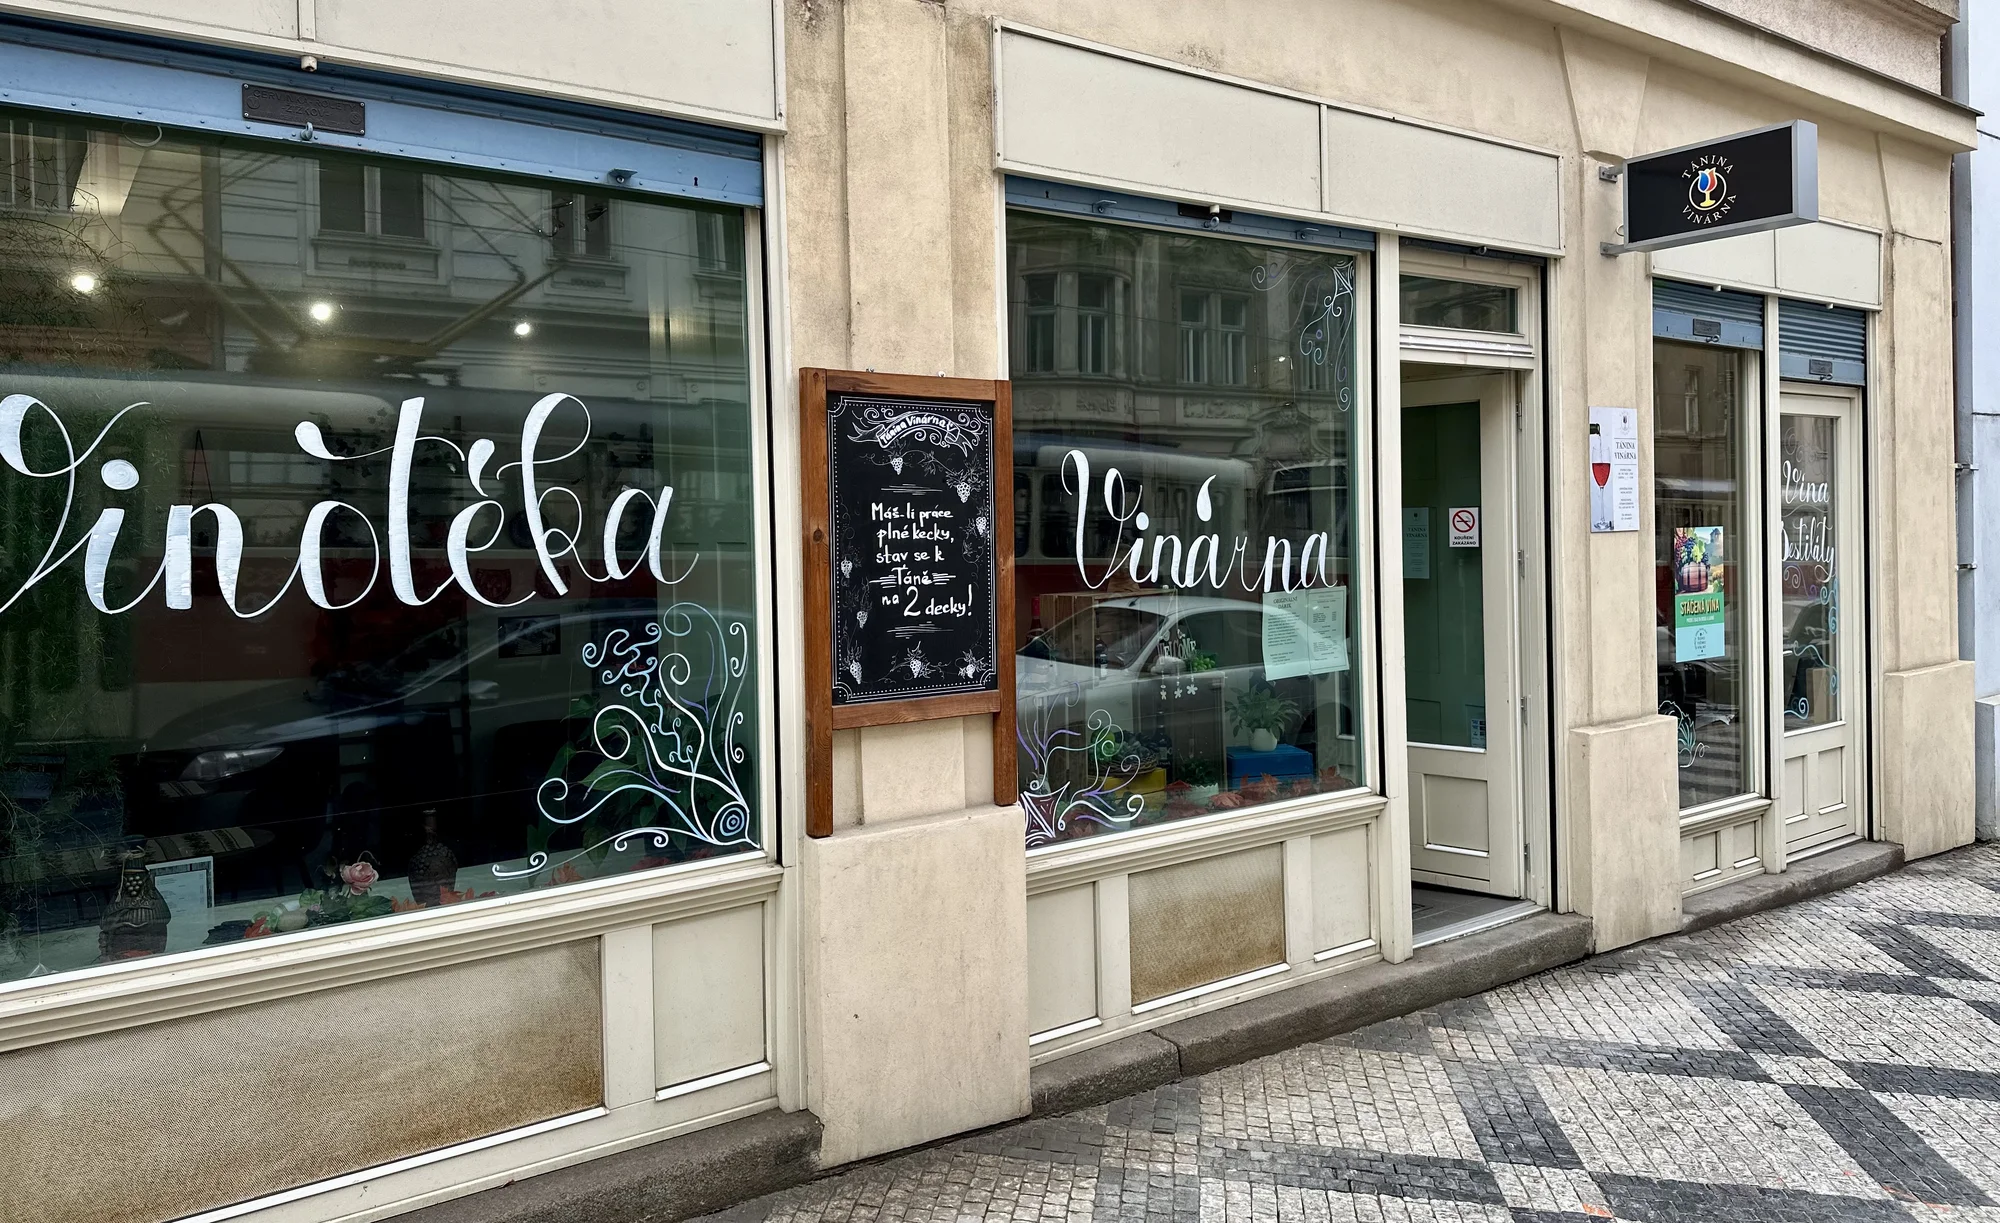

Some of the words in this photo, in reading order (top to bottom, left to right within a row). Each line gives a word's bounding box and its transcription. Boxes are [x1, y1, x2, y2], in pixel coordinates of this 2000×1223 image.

[1682, 154, 1734, 180] TÁNINA
[1682, 193, 1737, 225] VINÁRNA
[906, 413, 947, 428] Vinárna
[1614, 451, 1637, 460] VINÁRNA
[1615, 441, 1635, 450] TÁNINA
[871, 502, 915, 521] Máš-li
[919, 505, 954, 528] práce
[1061, 449, 1338, 594] Vinárna
[876, 522, 910, 548] plné
[912, 522, 955, 543] kecky,
[876, 544, 909, 563] stav
[913, 551, 931, 561] se
[934, 545, 945, 562] k
[881, 594, 899, 605] na
[903, 585, 921, 617] 2
[925, 584, 973, 617] decky!
